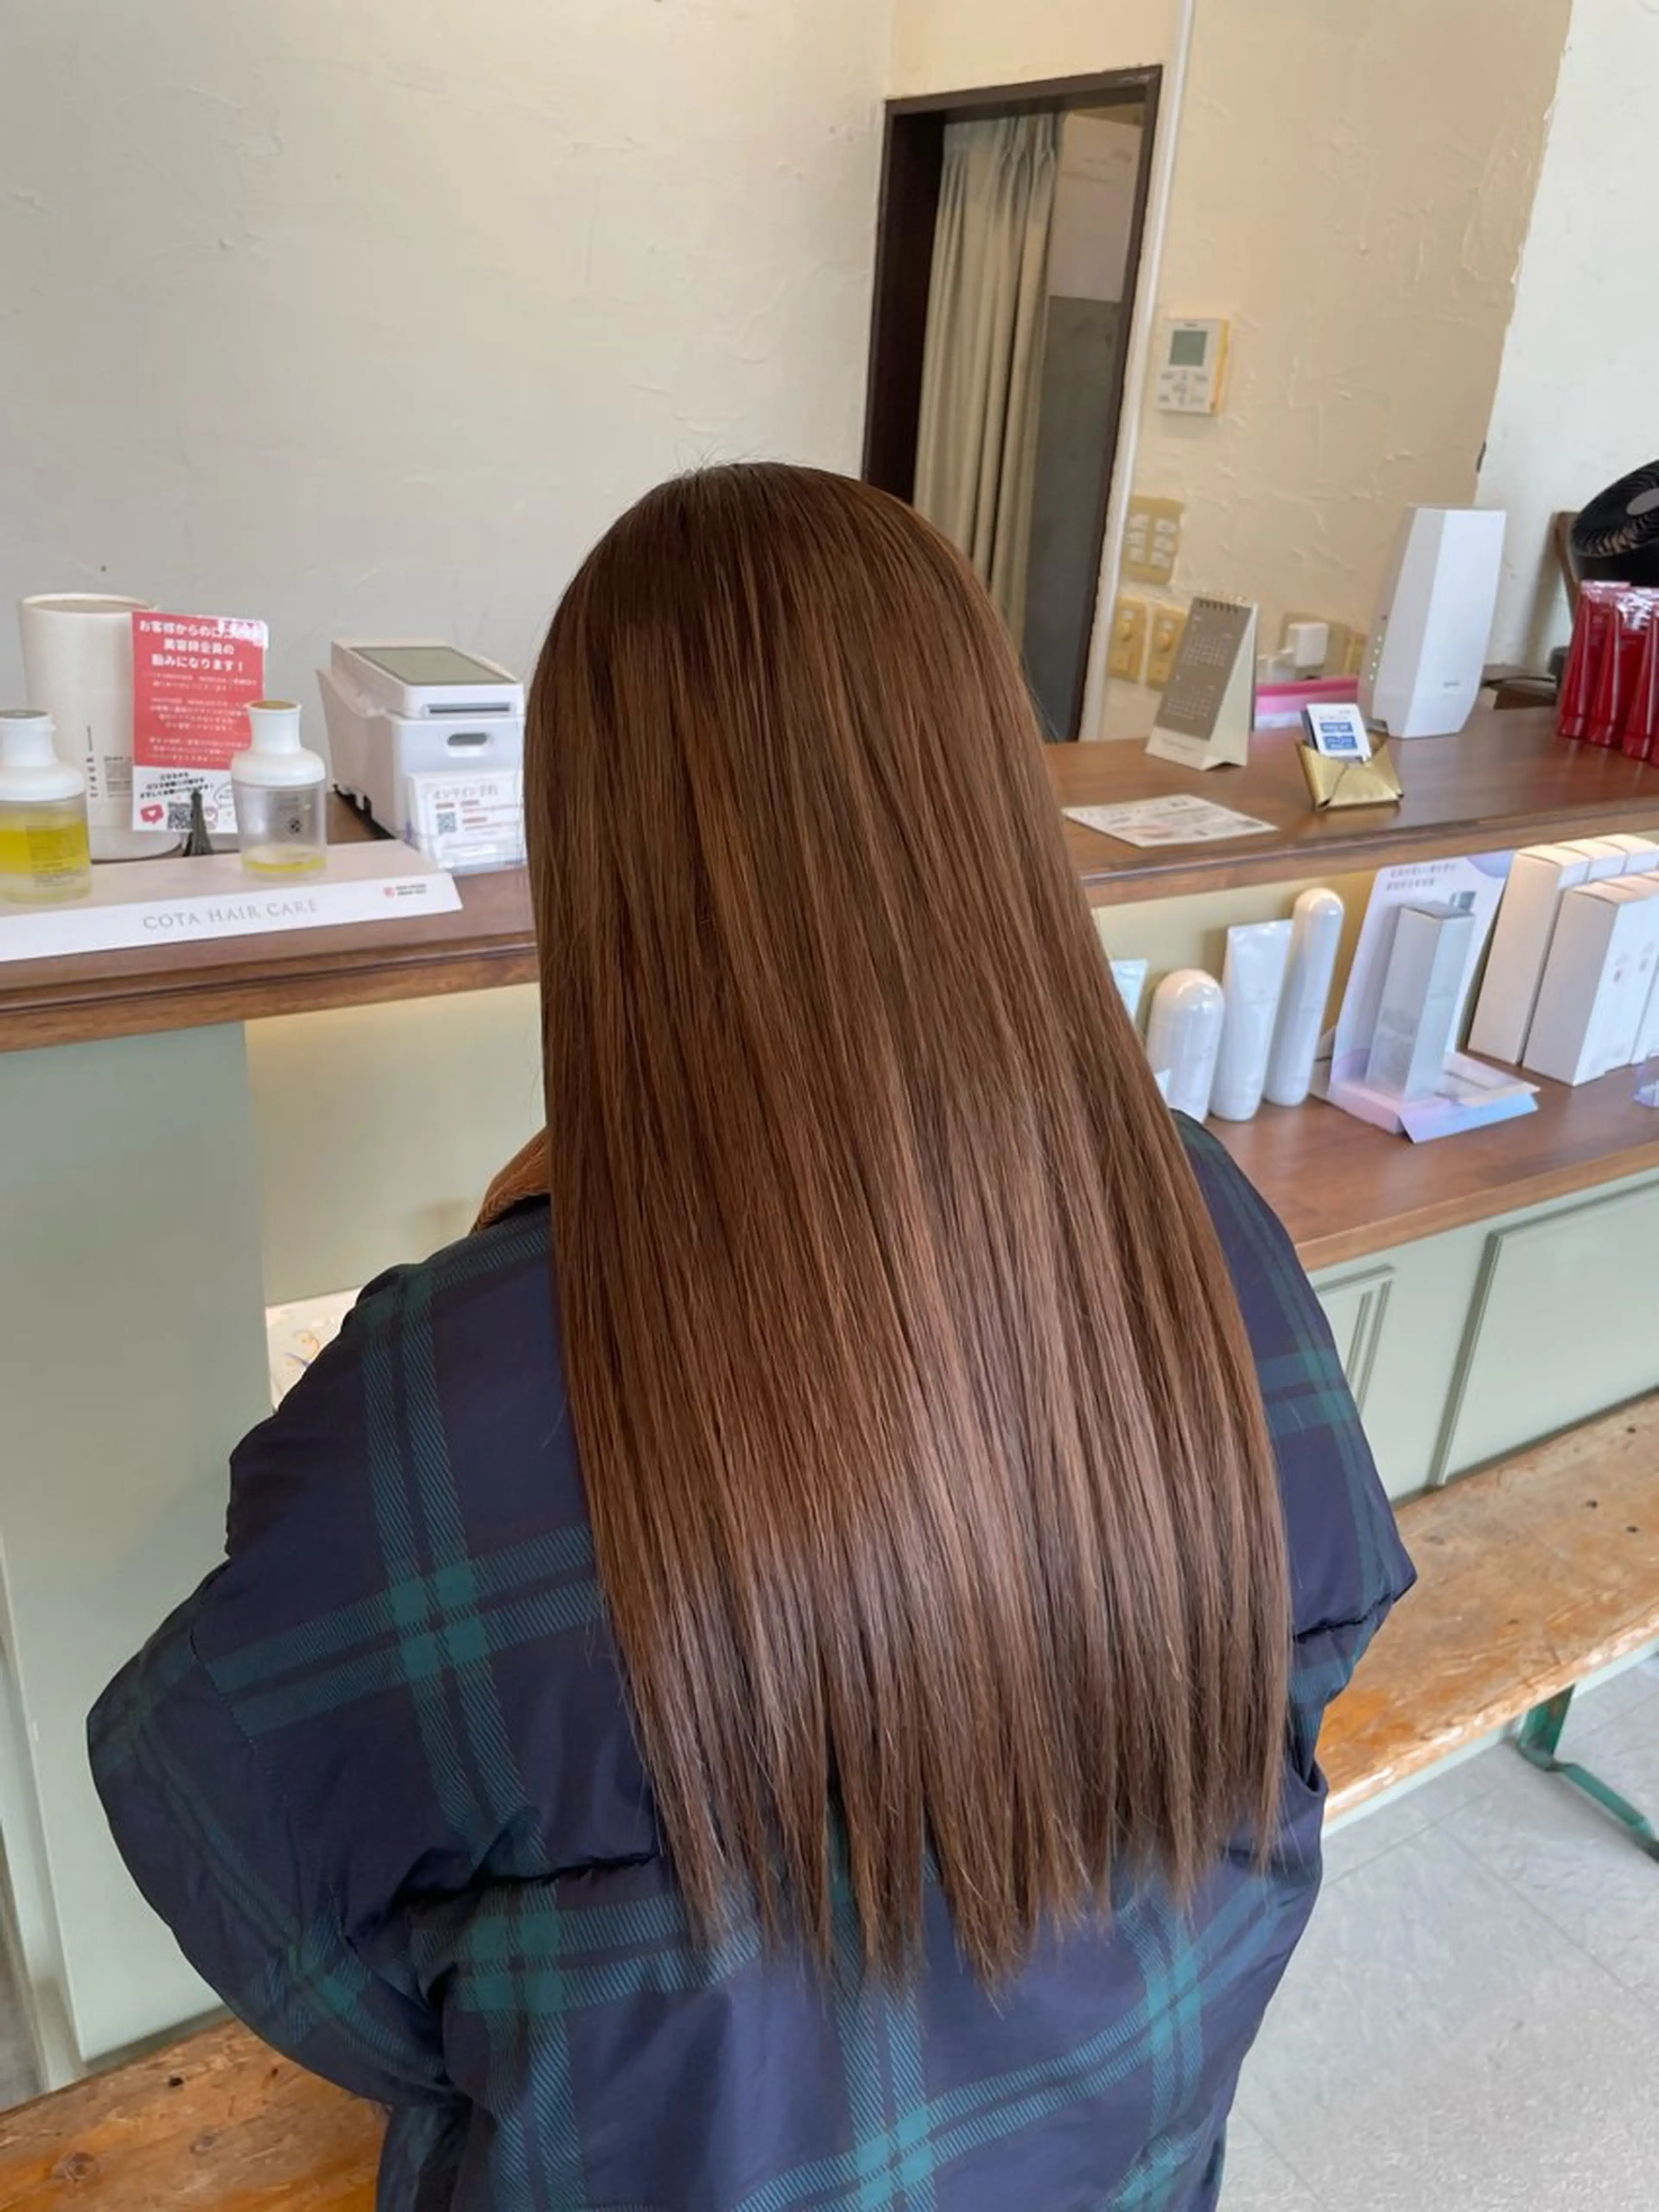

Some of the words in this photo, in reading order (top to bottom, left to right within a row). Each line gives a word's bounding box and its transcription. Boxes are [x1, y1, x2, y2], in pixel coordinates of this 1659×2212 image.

[143, 912, 200, 929] COTA
[207, 905, 261, 922] HAIR
[266, 899, 318, 917] CARE
